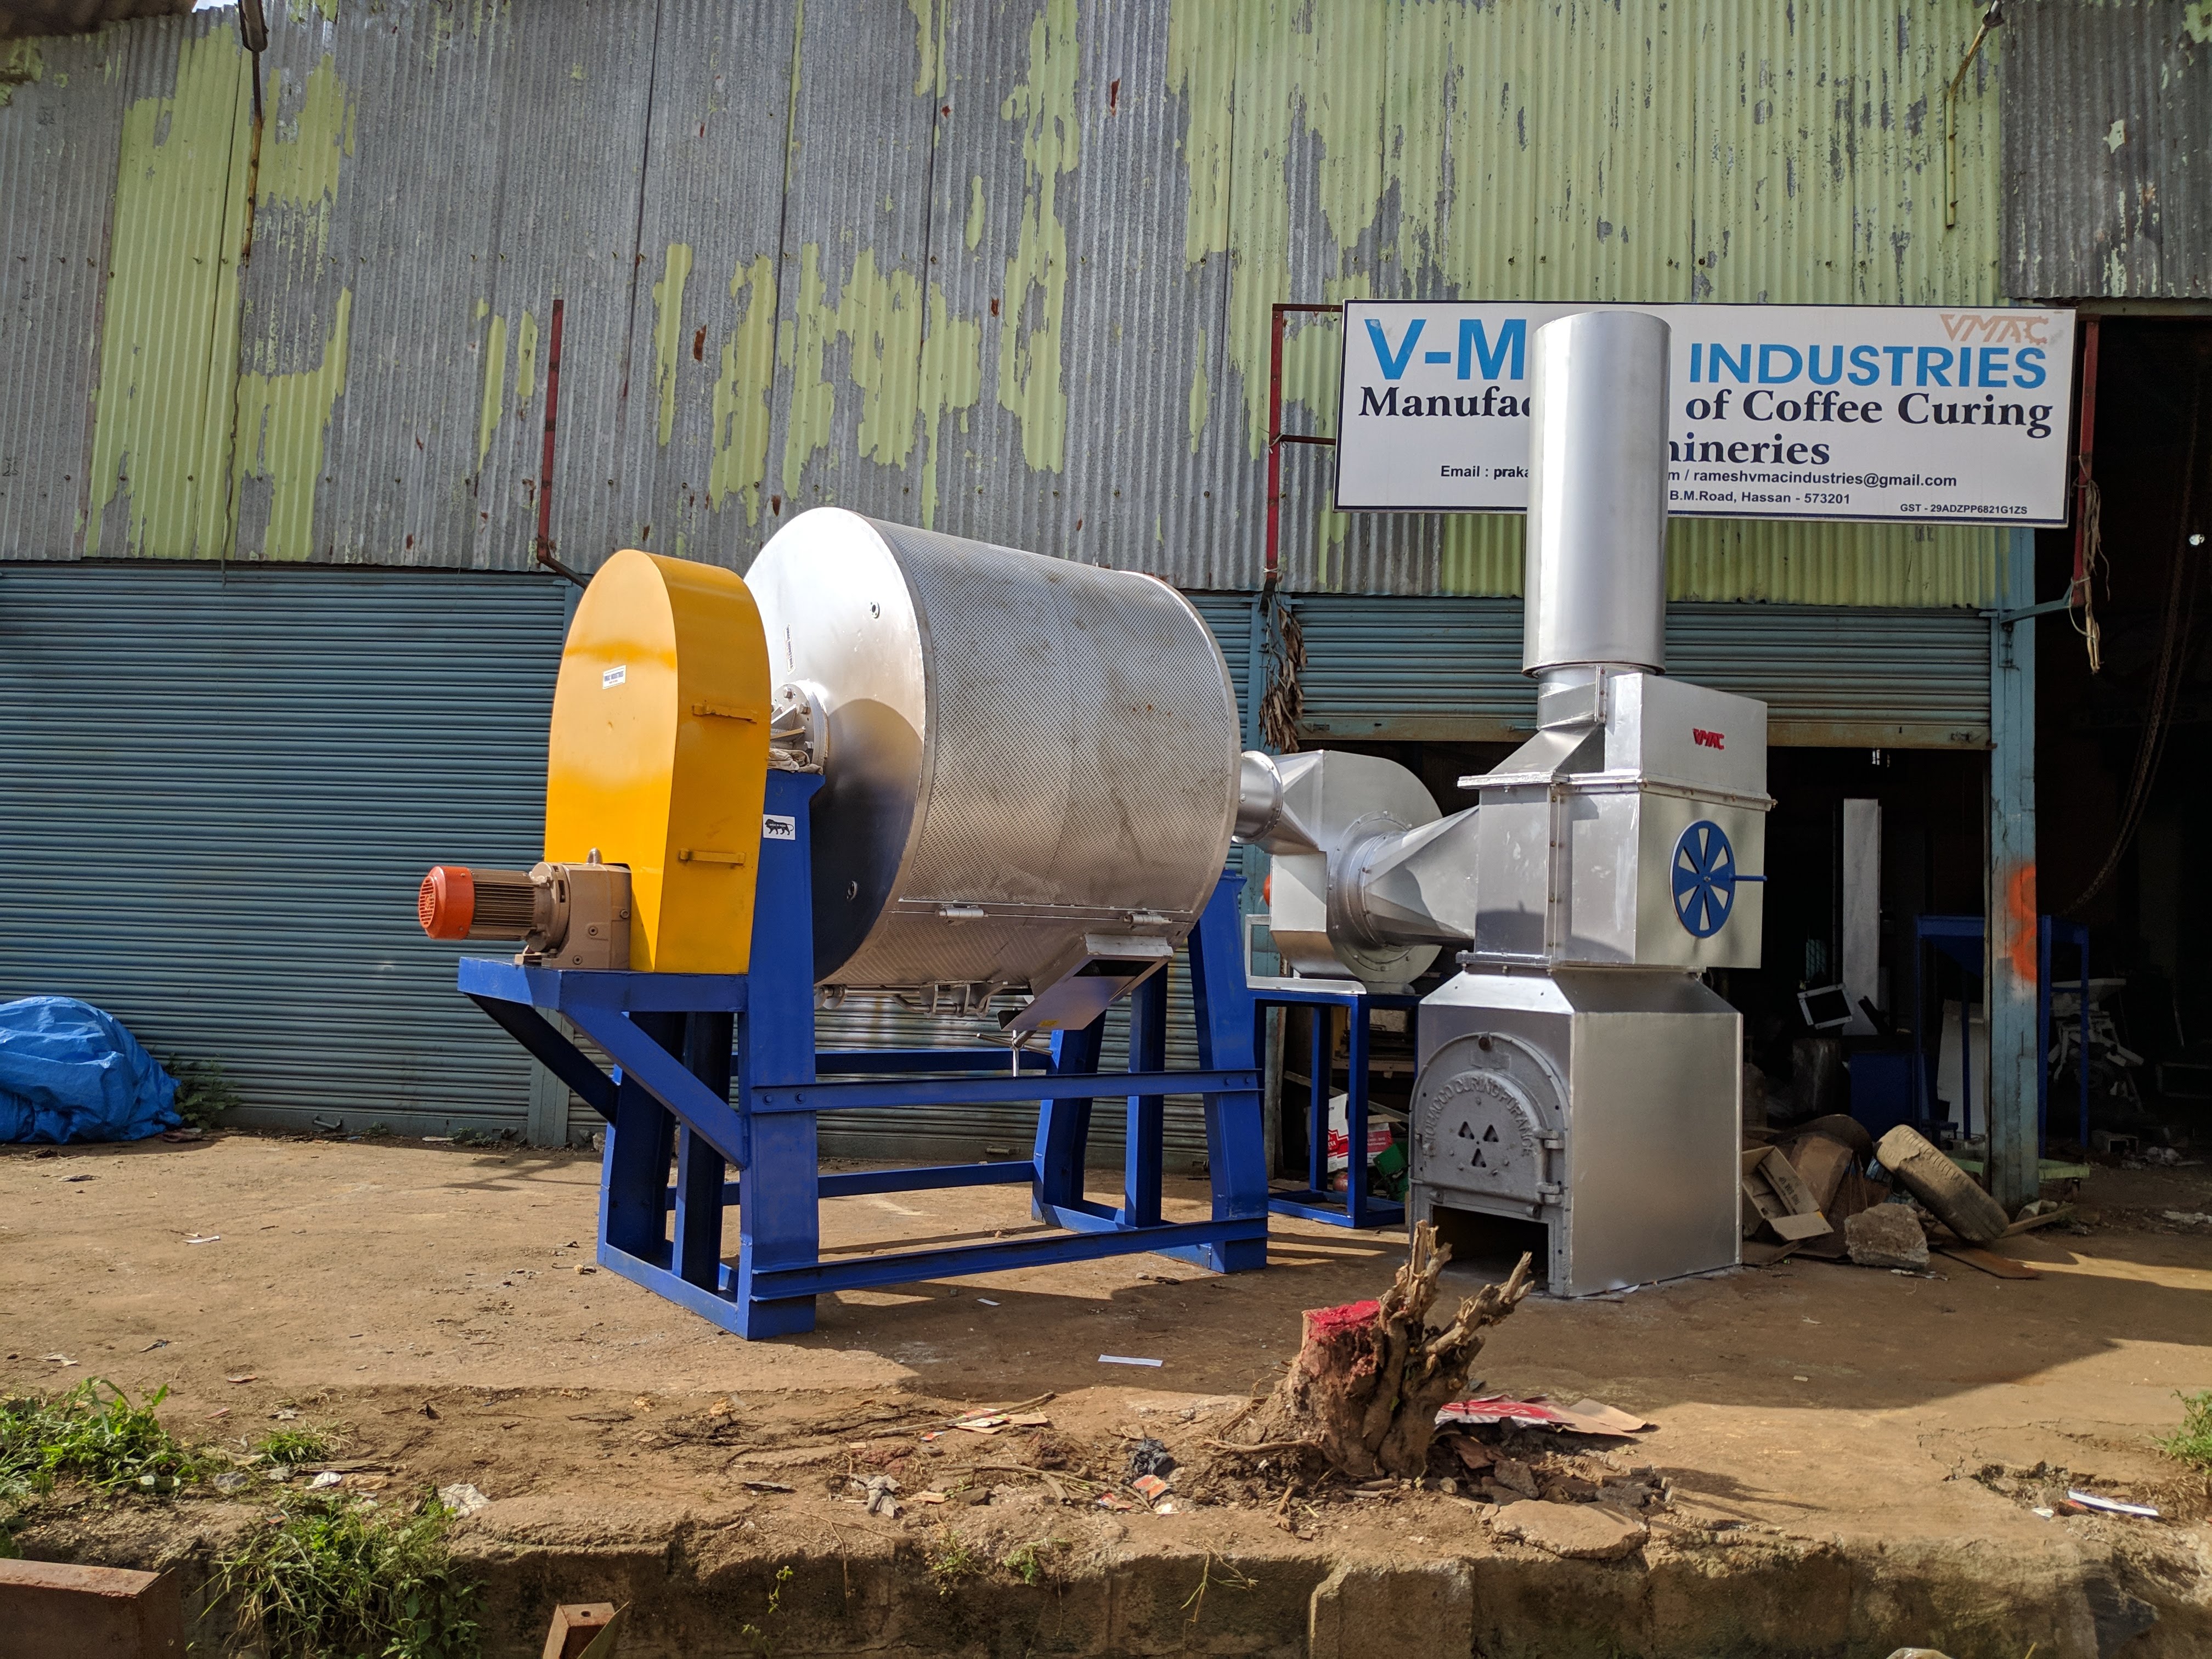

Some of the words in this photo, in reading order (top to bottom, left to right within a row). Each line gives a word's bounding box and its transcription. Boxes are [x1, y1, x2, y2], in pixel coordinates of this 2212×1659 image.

[1940, 314, 2049, 346] VMAC
[1690, 342, 2046, 389] INDUSTRIES
[1685, 388, 1732, 421] of
[1743, 389, 1882, 424] Coffee
[1898, 392, 2053, 439] Curing
[1441, 465, 1480, 477] Email
[1684, 469, 1690, 481] /
[1694, 470, 1957, 488] rameshvmacindustries@gmail.com
[1670, 490, 1737, 503] B.M.Road,
[1741, 492, 1791, 503] Hassan
[1804, 493, 1849, 504] 573201
[1900, 504, 1922, 512] GST
[1693, 728, 1725, 750] VMAC
[1454, 1076, 1501, 1098] CURING
